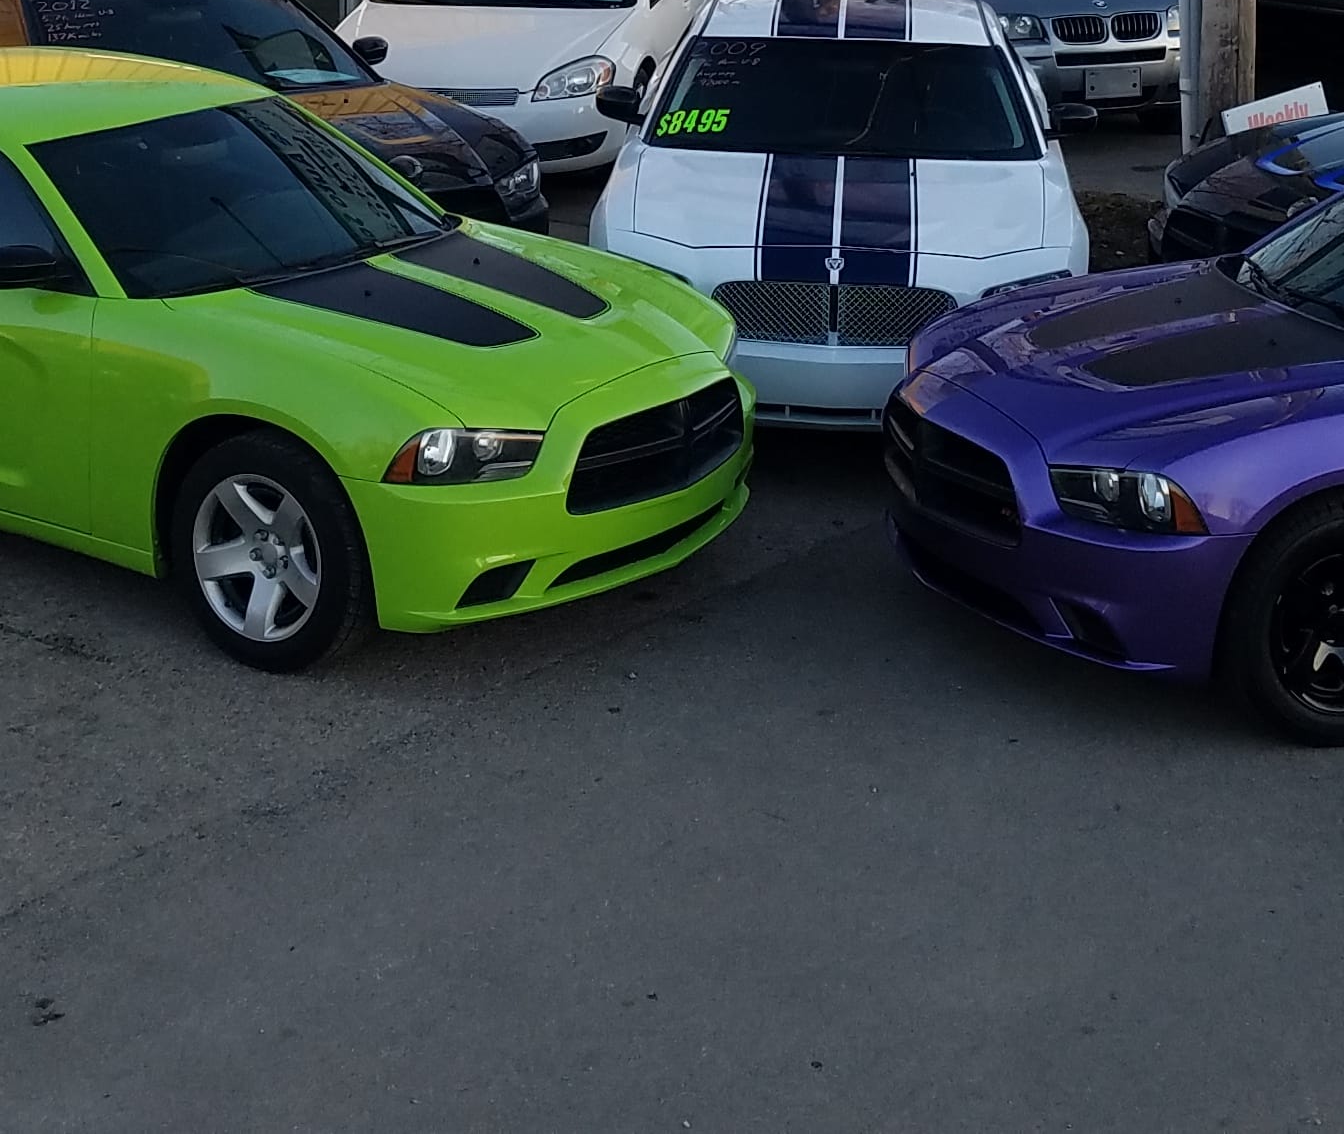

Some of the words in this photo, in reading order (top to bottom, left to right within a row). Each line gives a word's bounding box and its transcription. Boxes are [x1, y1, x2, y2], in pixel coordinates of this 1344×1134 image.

[36, 0, 91, 13] 2012
[690, 41, 767, 57] 2009
[656, 109, 731, 137] $8495
